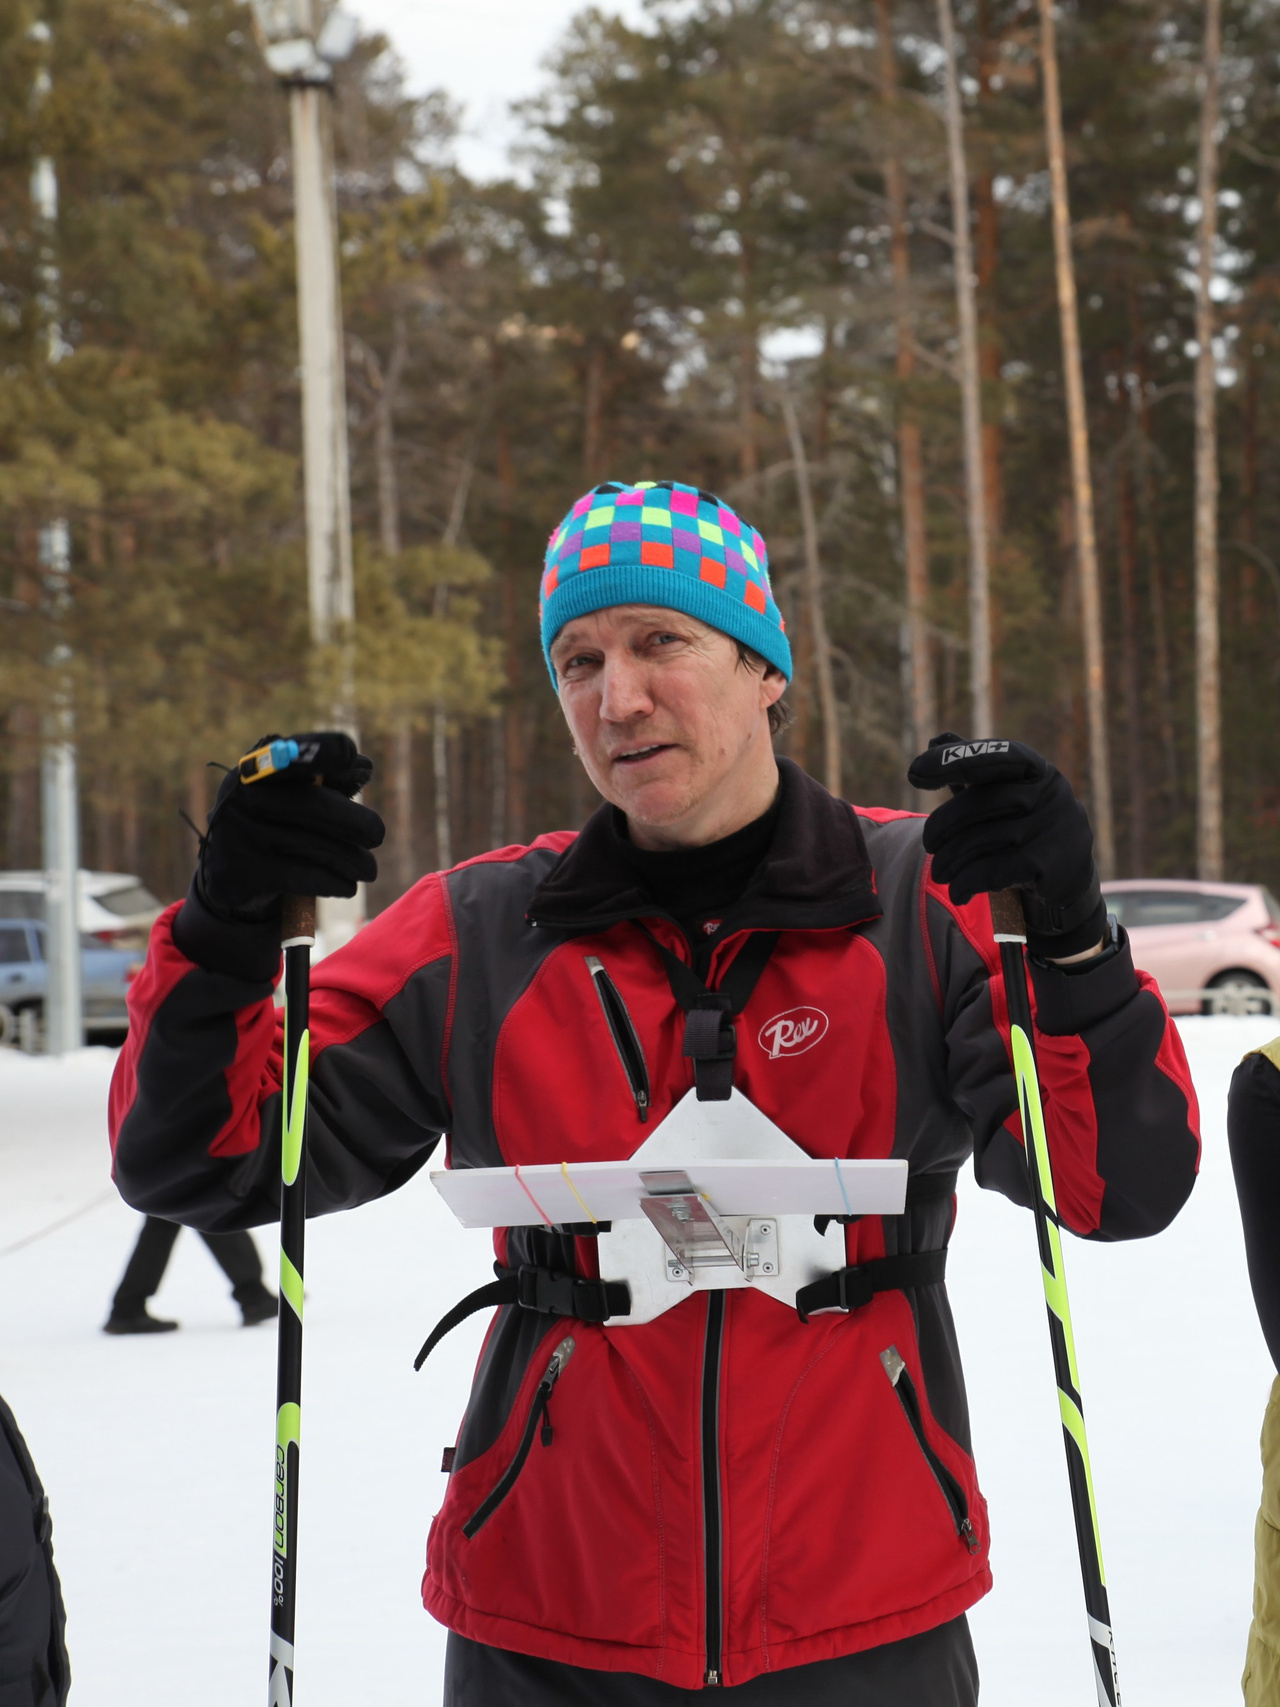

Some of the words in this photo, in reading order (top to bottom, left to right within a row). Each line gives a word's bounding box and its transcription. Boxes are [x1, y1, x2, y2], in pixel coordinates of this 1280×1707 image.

[942, 741, 1009, 766] KV+
[764, 1017, 819, 1057] Rex
[273, 1554, 285, 1607] 100%
